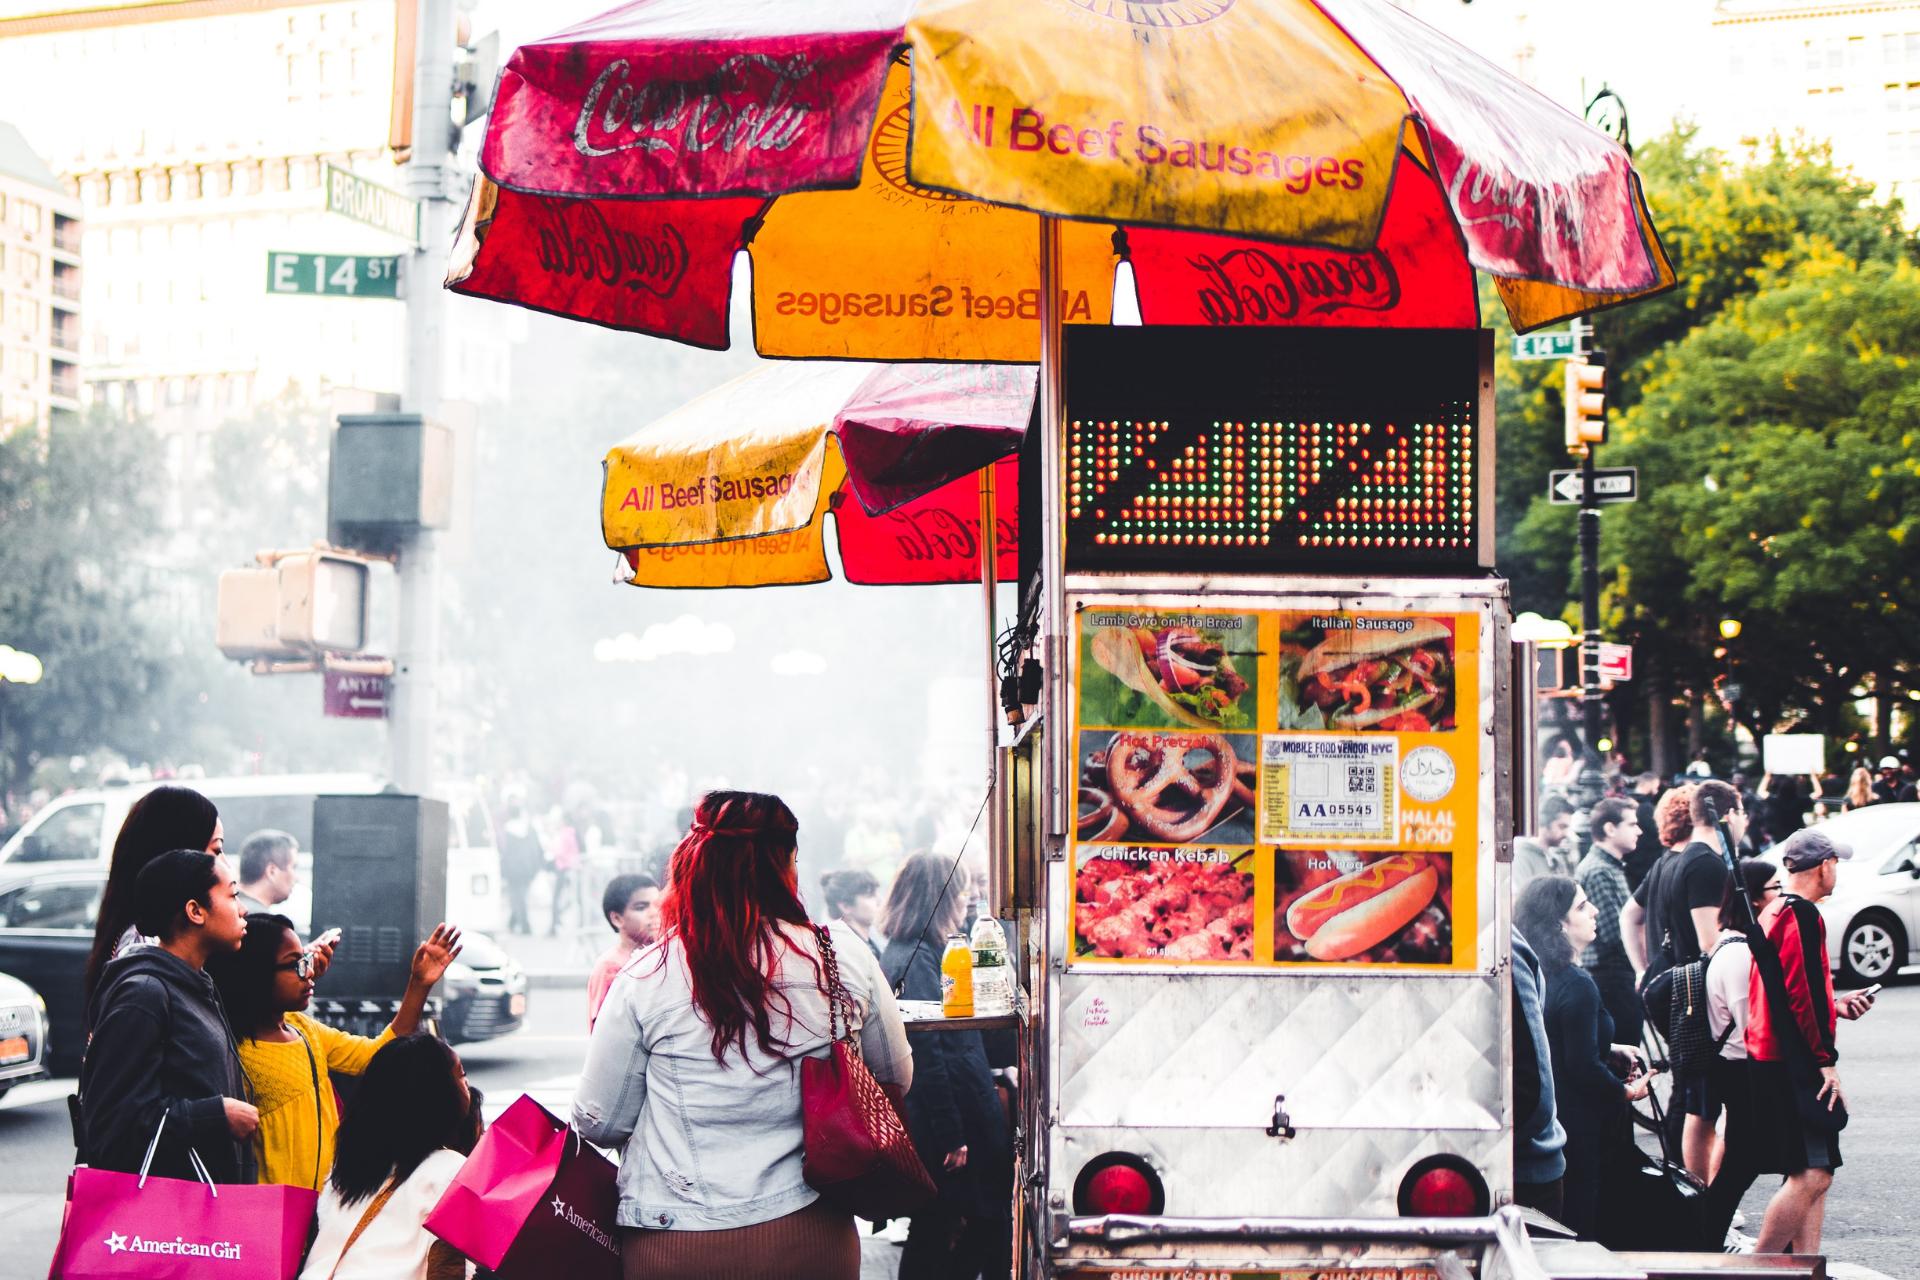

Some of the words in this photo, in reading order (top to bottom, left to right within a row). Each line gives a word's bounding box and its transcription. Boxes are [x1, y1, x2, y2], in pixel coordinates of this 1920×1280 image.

[572, 52, 822, 158] CocaCola
[943, 97, 995, 147] All
[1009, 107, 1123, 160] Beef
[1134, 124, 1364, 195] Sausages
[274, 254, 299, 293] E
[313, 255, 358, 295] 14
[367, 258, 394, 280] ST
[620, 487, 655, 512] All
[660, 477, 706, 510] Beef
[710, 472, 798, 504] Sausag
[1600, 480, 1624, 490] WAY
[1091, 614, 1125, 627] Lamb
[1128, 614, 1157, 630] Gyro
[1160, 616, 1177, 628] on
[1180, 616, 1203, 629] Pita
[1205, 616, 1243, 629] Bread
[1311, 615, 1352, 629] Italian
[1356, 615, 1415, 633] Sausage
[1119, 733, 1149, 748] Hot
[1282, 741, 1313, 754] MOBILE
[1315, 742, 1336, 754] FOOD
[1337, 742, 1369, 754] VENDOR
[1371, 743, 1393, 755] NYC
[1401, 809, 1456, 827] HALAL
[1101, 846, 1170, 862] Chicken
[1174, 847, 1230, 864] Kebab
[1307, 857, 1332, 870] Hot
[1146, 947, 1158, 956] on
[564, 1205, 609, 1248] American
[130, 1235, 210, 1257] American
[210, 1241, 241, 1260] Girl
